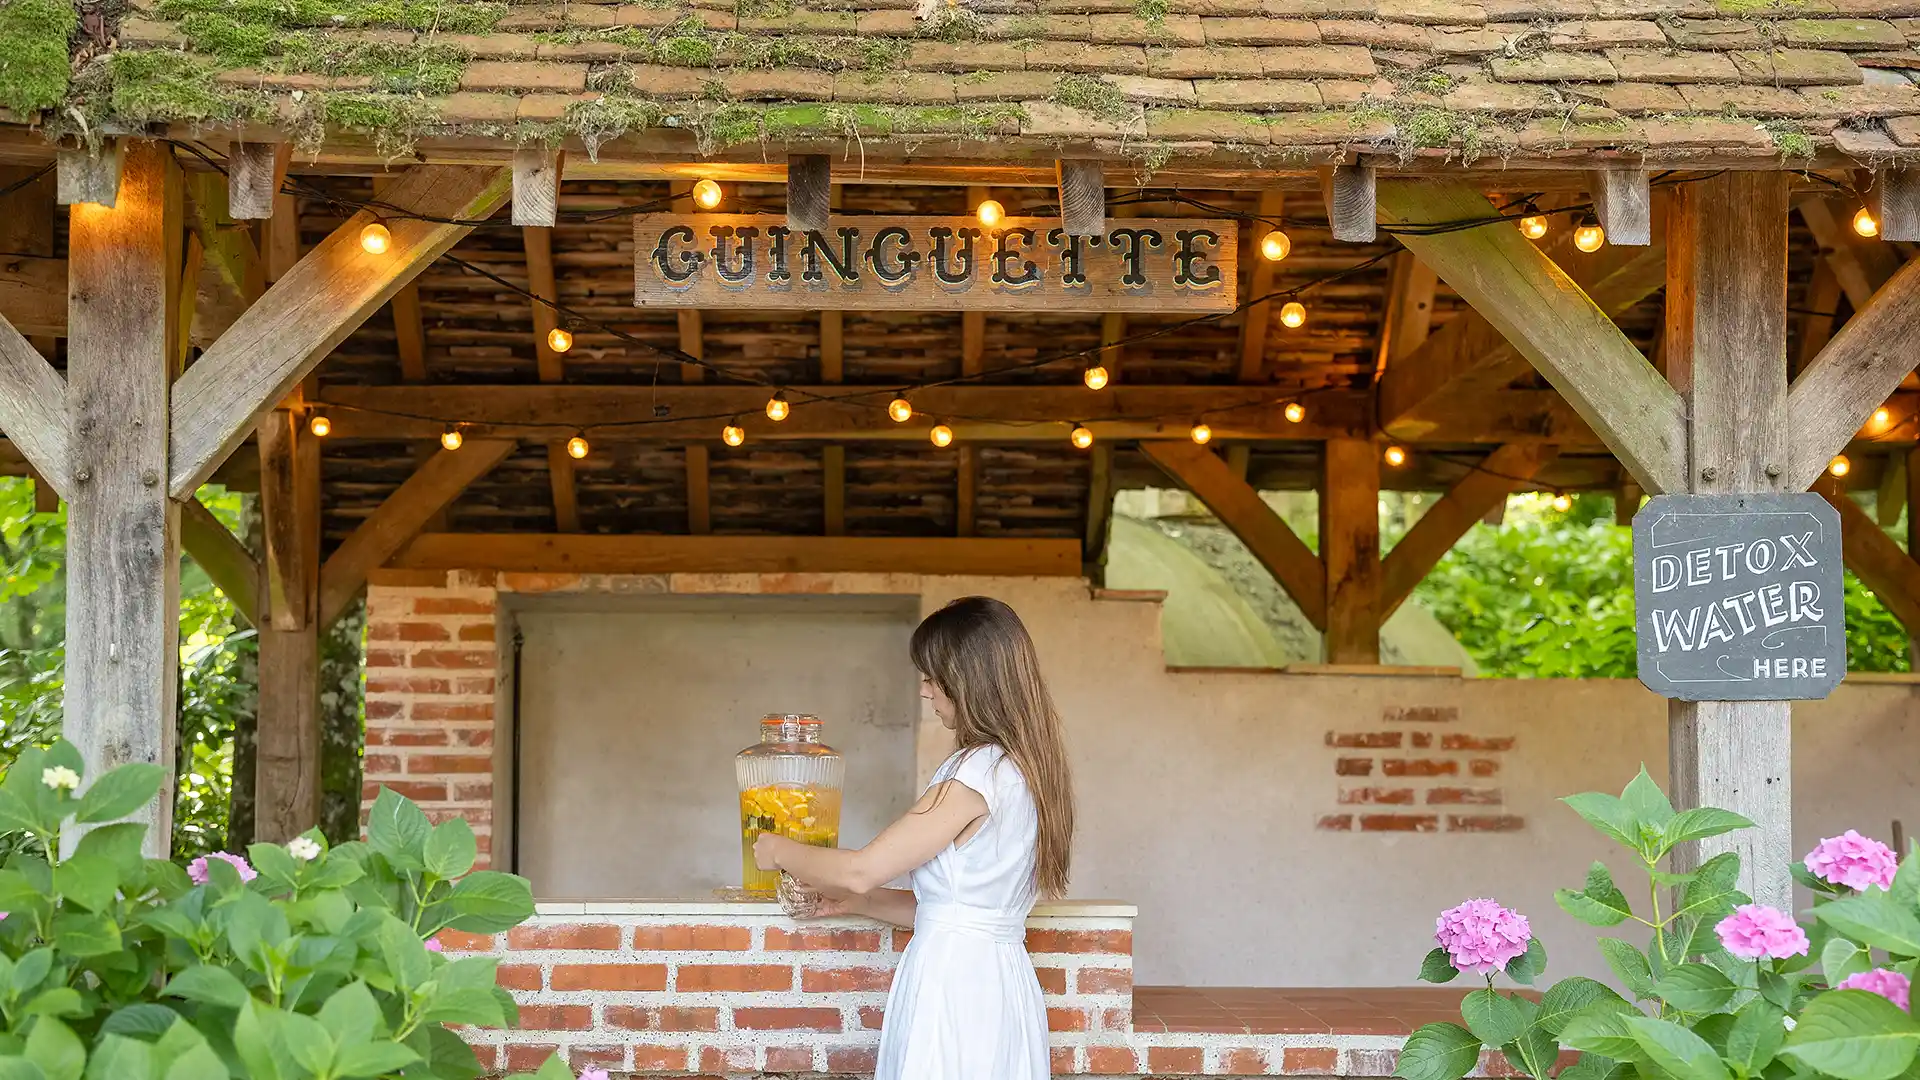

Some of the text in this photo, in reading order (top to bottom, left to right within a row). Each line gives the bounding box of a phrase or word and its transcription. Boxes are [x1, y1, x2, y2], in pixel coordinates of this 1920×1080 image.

[651, 225, 1225, 288] GUINGUETTE
[1652, 532, 1817, 592] DETOX
[1651, 581, 1824, 652] WATER
[1753, 658, 1827, 678] HERE
